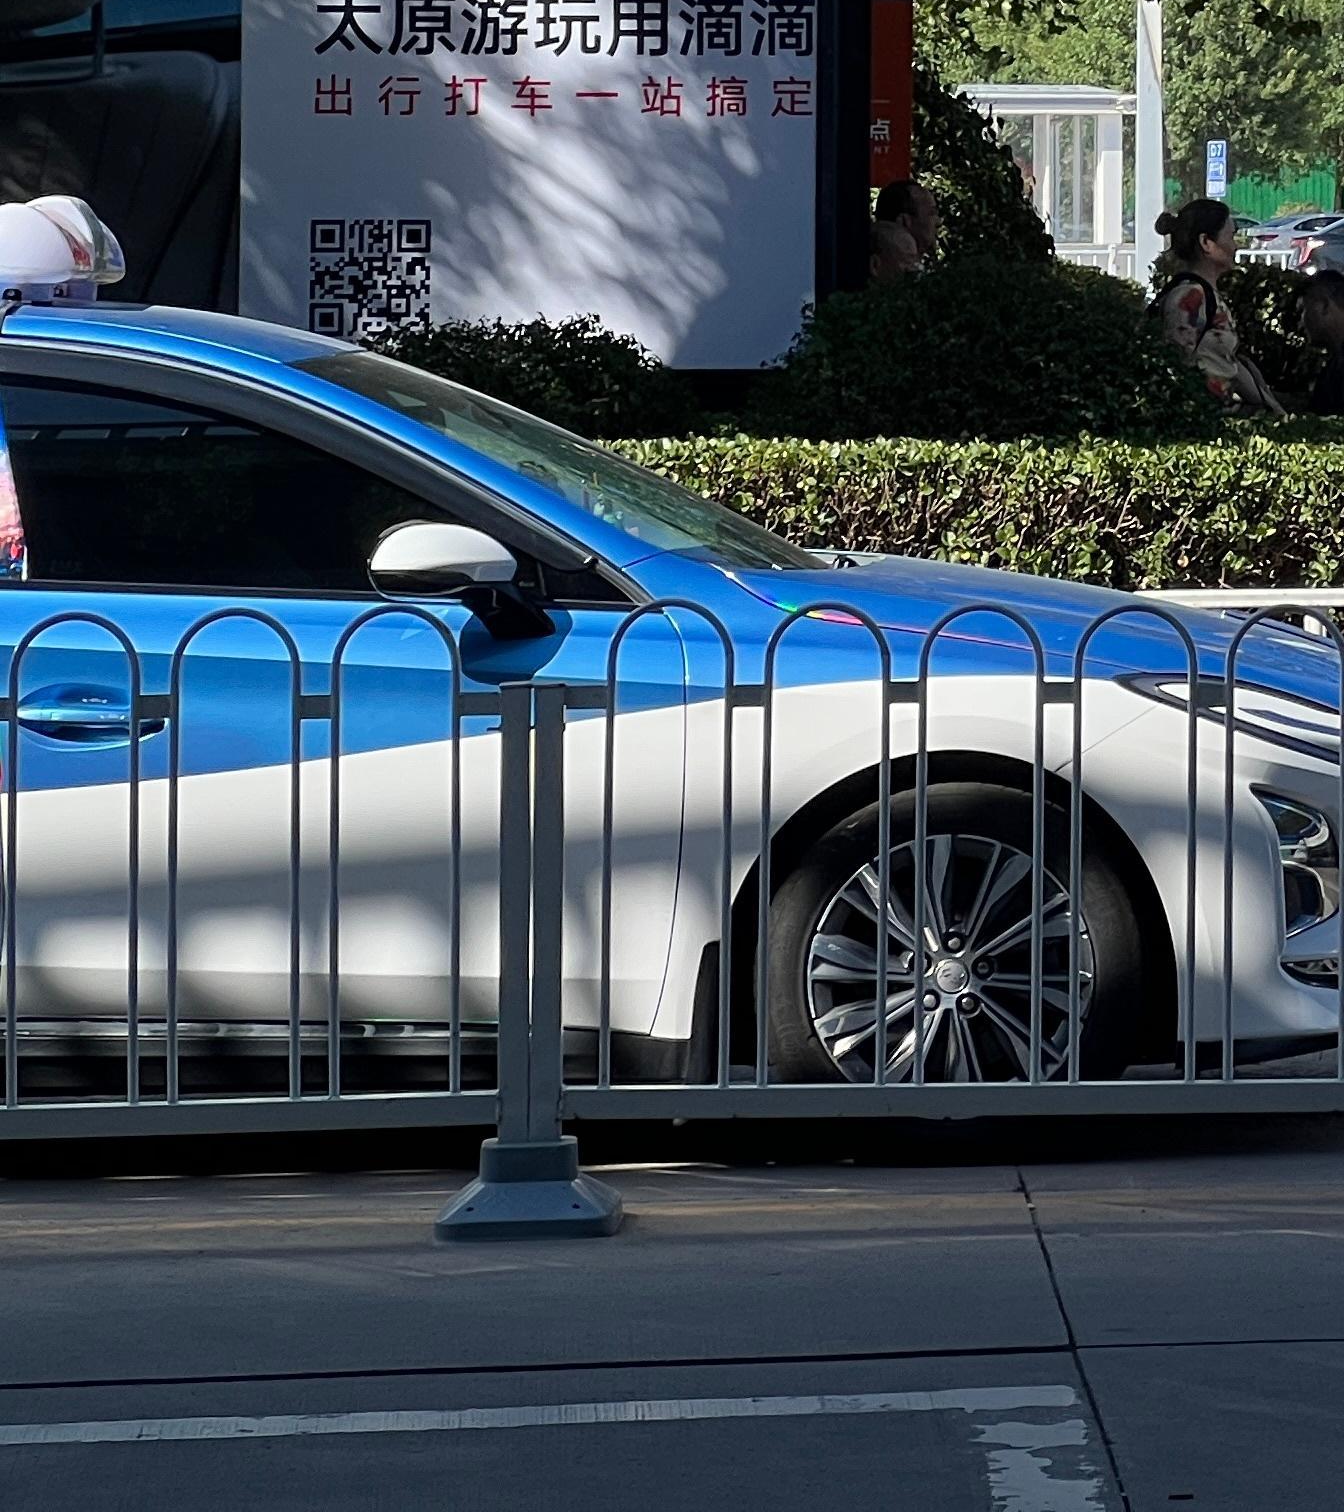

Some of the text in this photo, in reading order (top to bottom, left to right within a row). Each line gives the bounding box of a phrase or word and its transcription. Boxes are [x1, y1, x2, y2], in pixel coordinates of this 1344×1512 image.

[313, 74, 815, 118] 出行打车一站搞定
